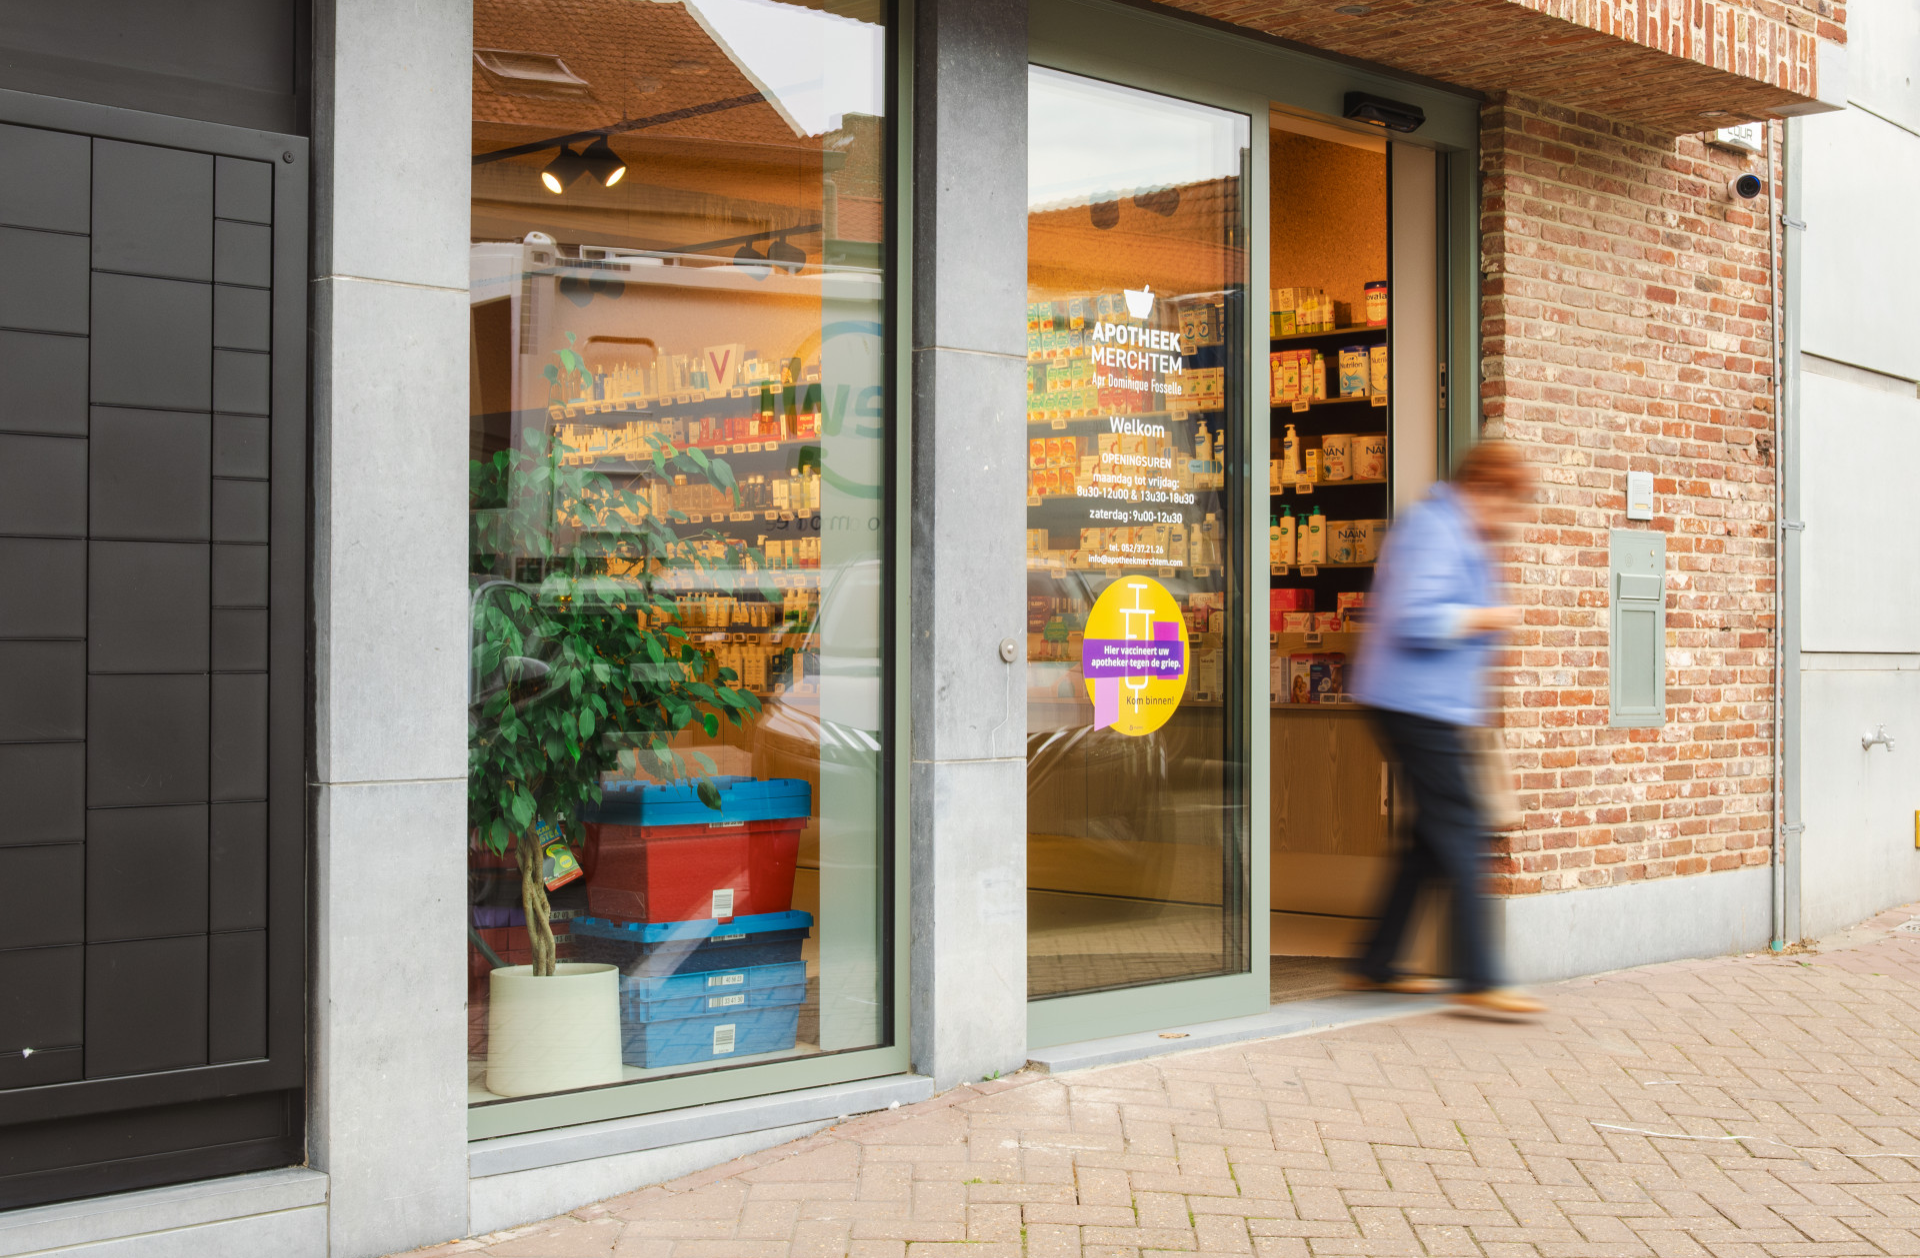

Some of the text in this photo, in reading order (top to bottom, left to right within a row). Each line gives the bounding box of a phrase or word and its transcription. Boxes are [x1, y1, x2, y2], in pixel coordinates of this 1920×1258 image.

[1092, 322, 1181, 352] APOTHEEK
[1091, 345, 1182, 375] MERCHTEM
[1092, 371, 1182, 395] Apr Dominique Fosselle
[1110, 416, 1165, 438] Welkom
[1102, 453, 1171, 469] OPENINGSUREN
[1093, 473, 1180, 490] maandag tot vrijdag:
[1077, 485, 1194, 504] 8u30-12u00 & 13u30-18u30
[1133, 510, 1182, 524] 9u00-12u30
[1109, 543, 1120, 552] tel.
[1088, 554, 1183, 567] info@apotheekmerchtem.com
[1104, 645, 1169, 656] Hier vaccineert uw
[1091, 657, 1181, 670] apotheker tegen de griep.
[1126, 696, 1175, 705] Kom binnen!
